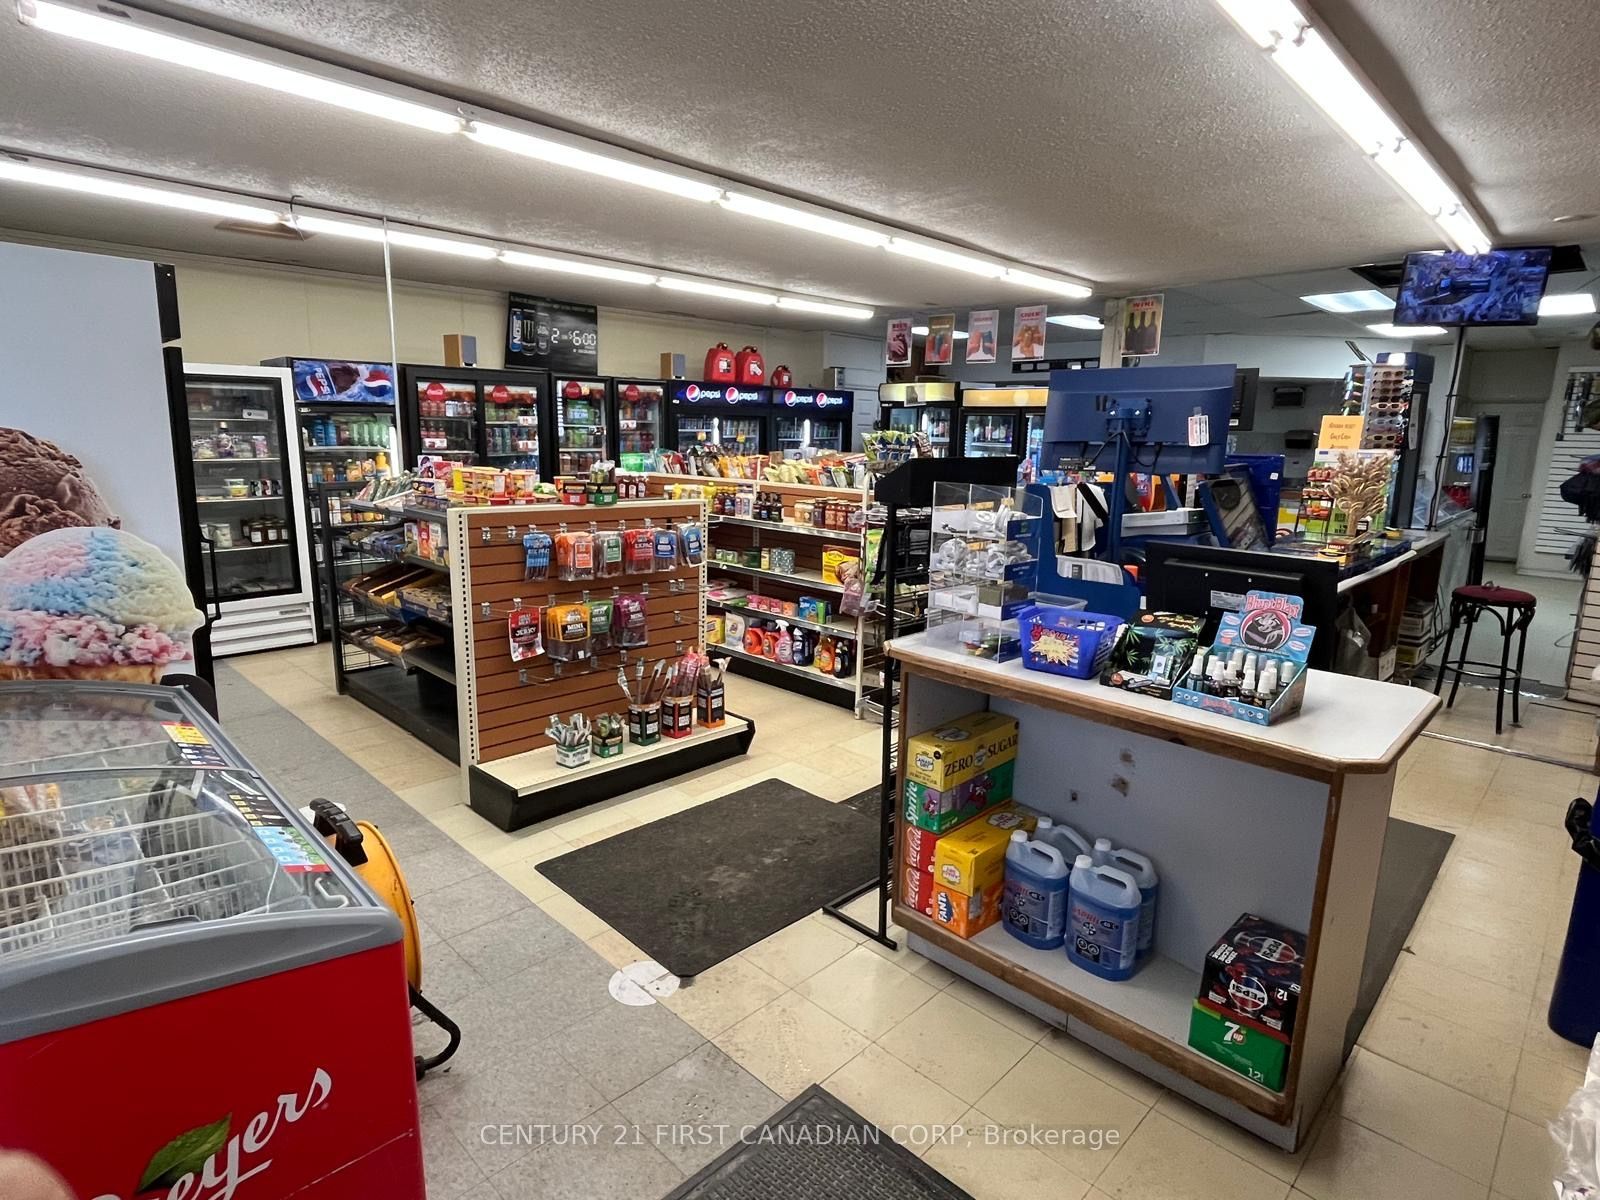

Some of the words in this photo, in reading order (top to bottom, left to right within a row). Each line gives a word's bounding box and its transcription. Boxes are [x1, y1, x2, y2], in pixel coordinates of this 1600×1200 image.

[551, 327, 560, 344] 2
[313, 367, 331, 395] PEPSI
[700, 389, 721, 399] pepsi
[739, 392, 758, 401] pepsi
[796, 395, 813, 404] pepsi
[826, 397, 843, 405] pepsi
[515, 627, 537, 636] JERKY
[944, 755, 973, 777] ZERO
[987, 735, 1019, 758] SUGAR
[905, 781, 919, 826] Sprite
[938, 892, 948, 922] FANTA
[1232, 983, 1264, 1001] PEPSI
[1247, 1067, 1261, 1081] 12
[90, 1067, 332, 1200] eyers
